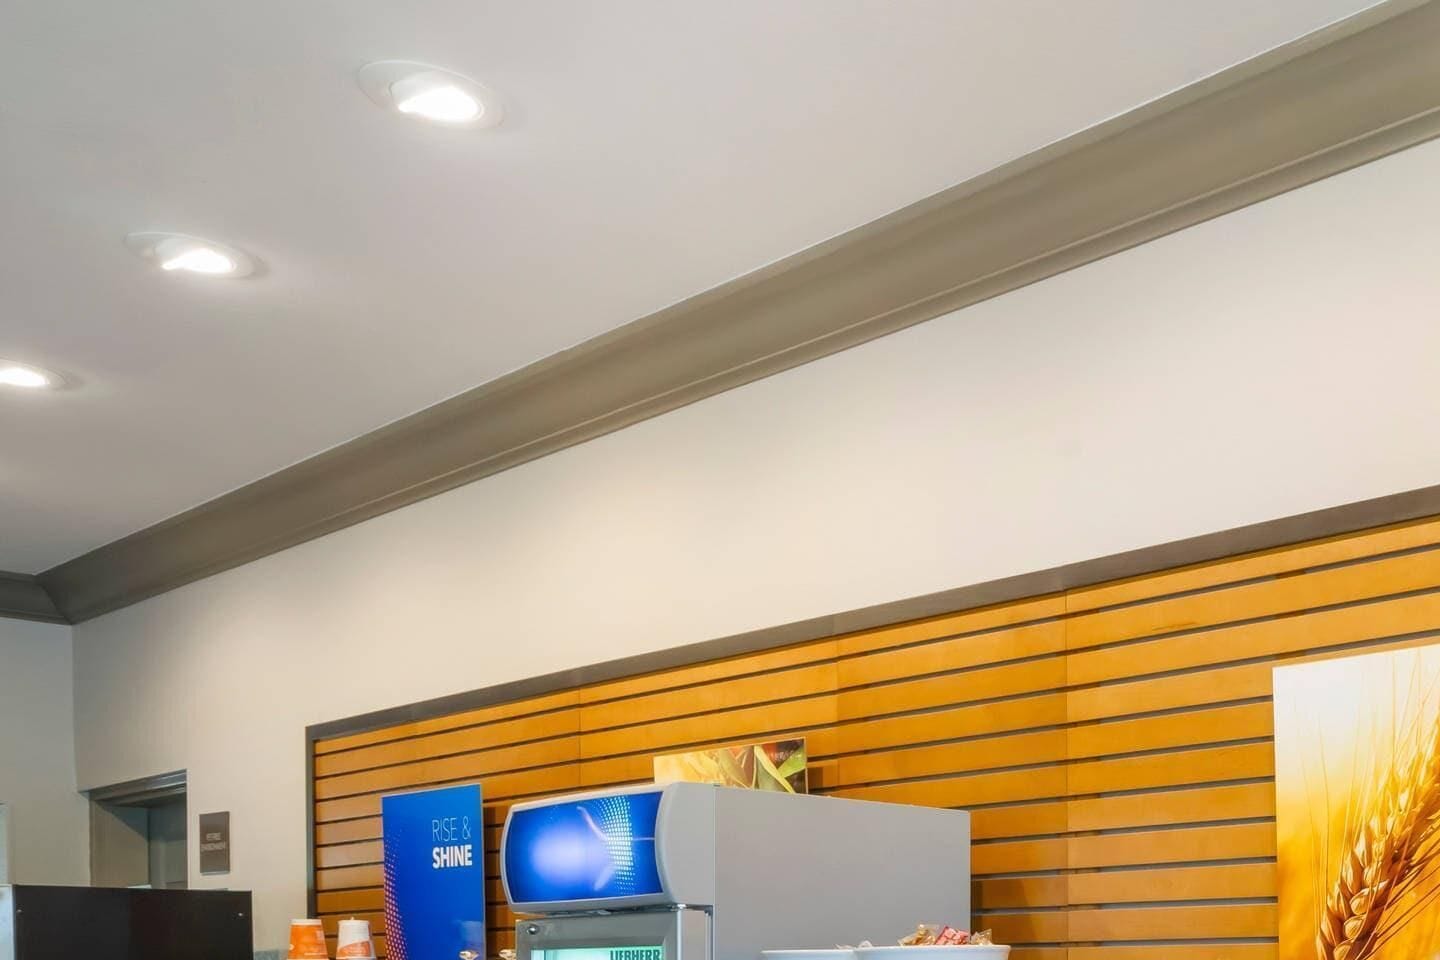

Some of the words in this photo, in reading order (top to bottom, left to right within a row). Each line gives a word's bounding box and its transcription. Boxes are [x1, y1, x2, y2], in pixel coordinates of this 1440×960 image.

[432, 816, 458, 841] RISE
[462, 815, 472, 840] &
[432, 844, 473, 869] SHINE
